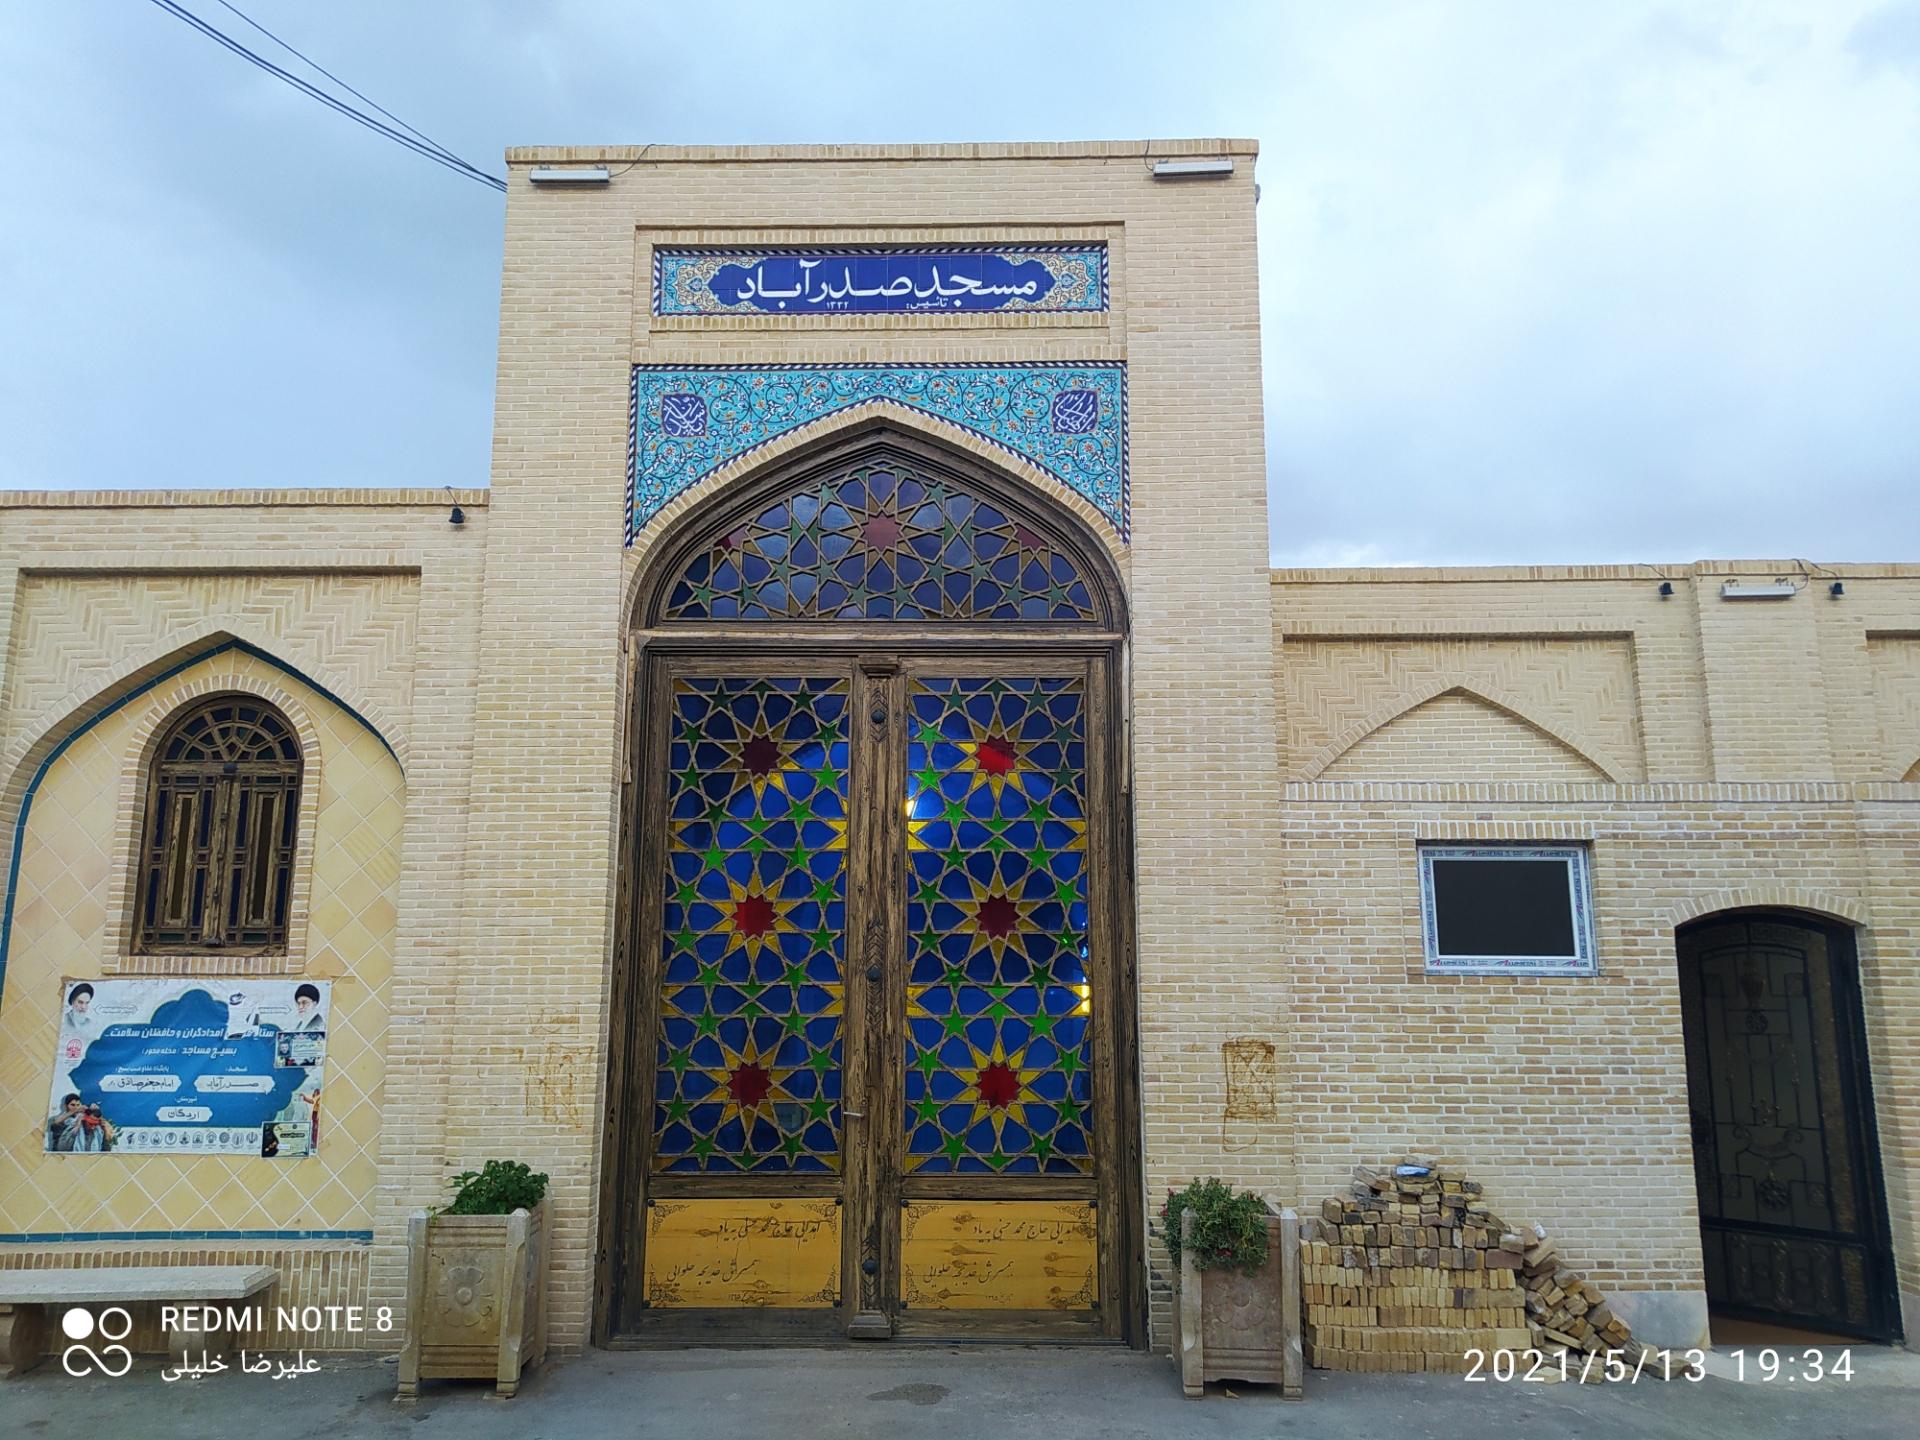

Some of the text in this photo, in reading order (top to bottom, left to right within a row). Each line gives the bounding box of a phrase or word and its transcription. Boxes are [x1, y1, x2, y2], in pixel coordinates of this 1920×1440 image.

[914, 265, 1037, 306] مسجد
[181, 1045, 210, 1057] مساجد
[208, 1046, 238, 1059] بسیج
